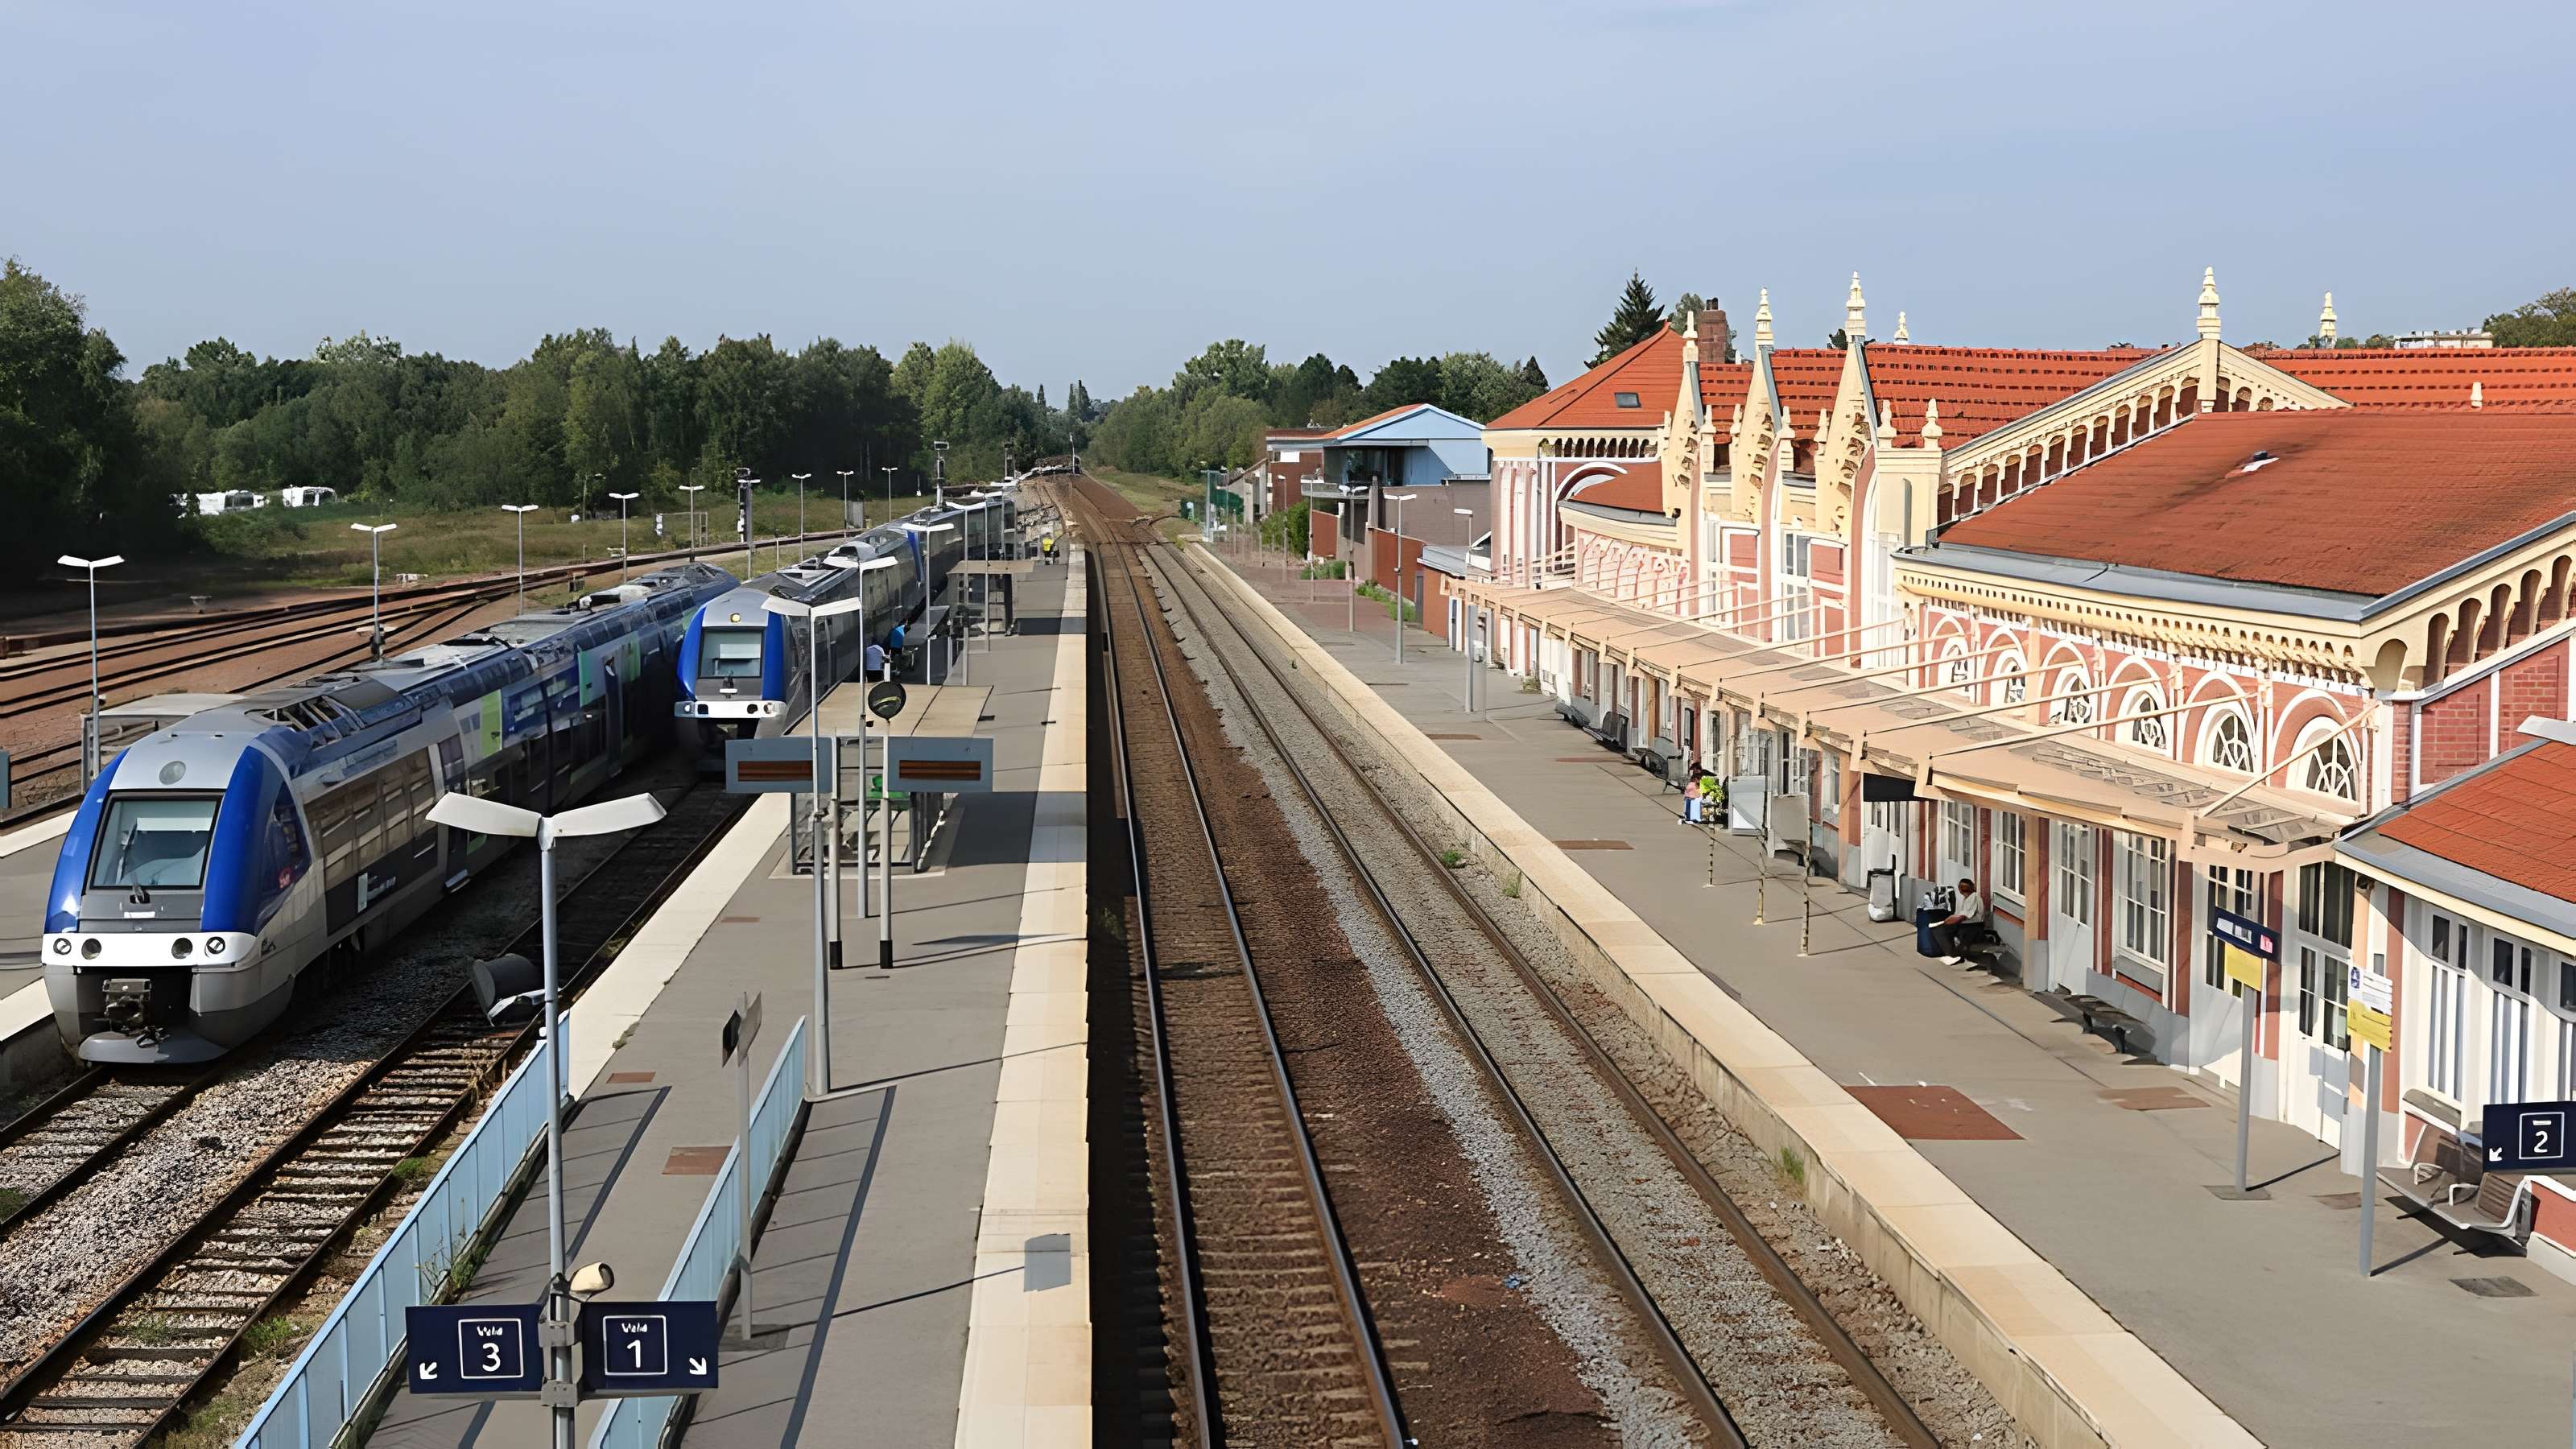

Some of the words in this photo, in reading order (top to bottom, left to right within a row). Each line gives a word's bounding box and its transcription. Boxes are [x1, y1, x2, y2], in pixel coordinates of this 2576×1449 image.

[2533, 1130, 2549, 1154] 2
[482, 1342, 501, 1372] 3
[626, 1340, 642, 1368] 1
